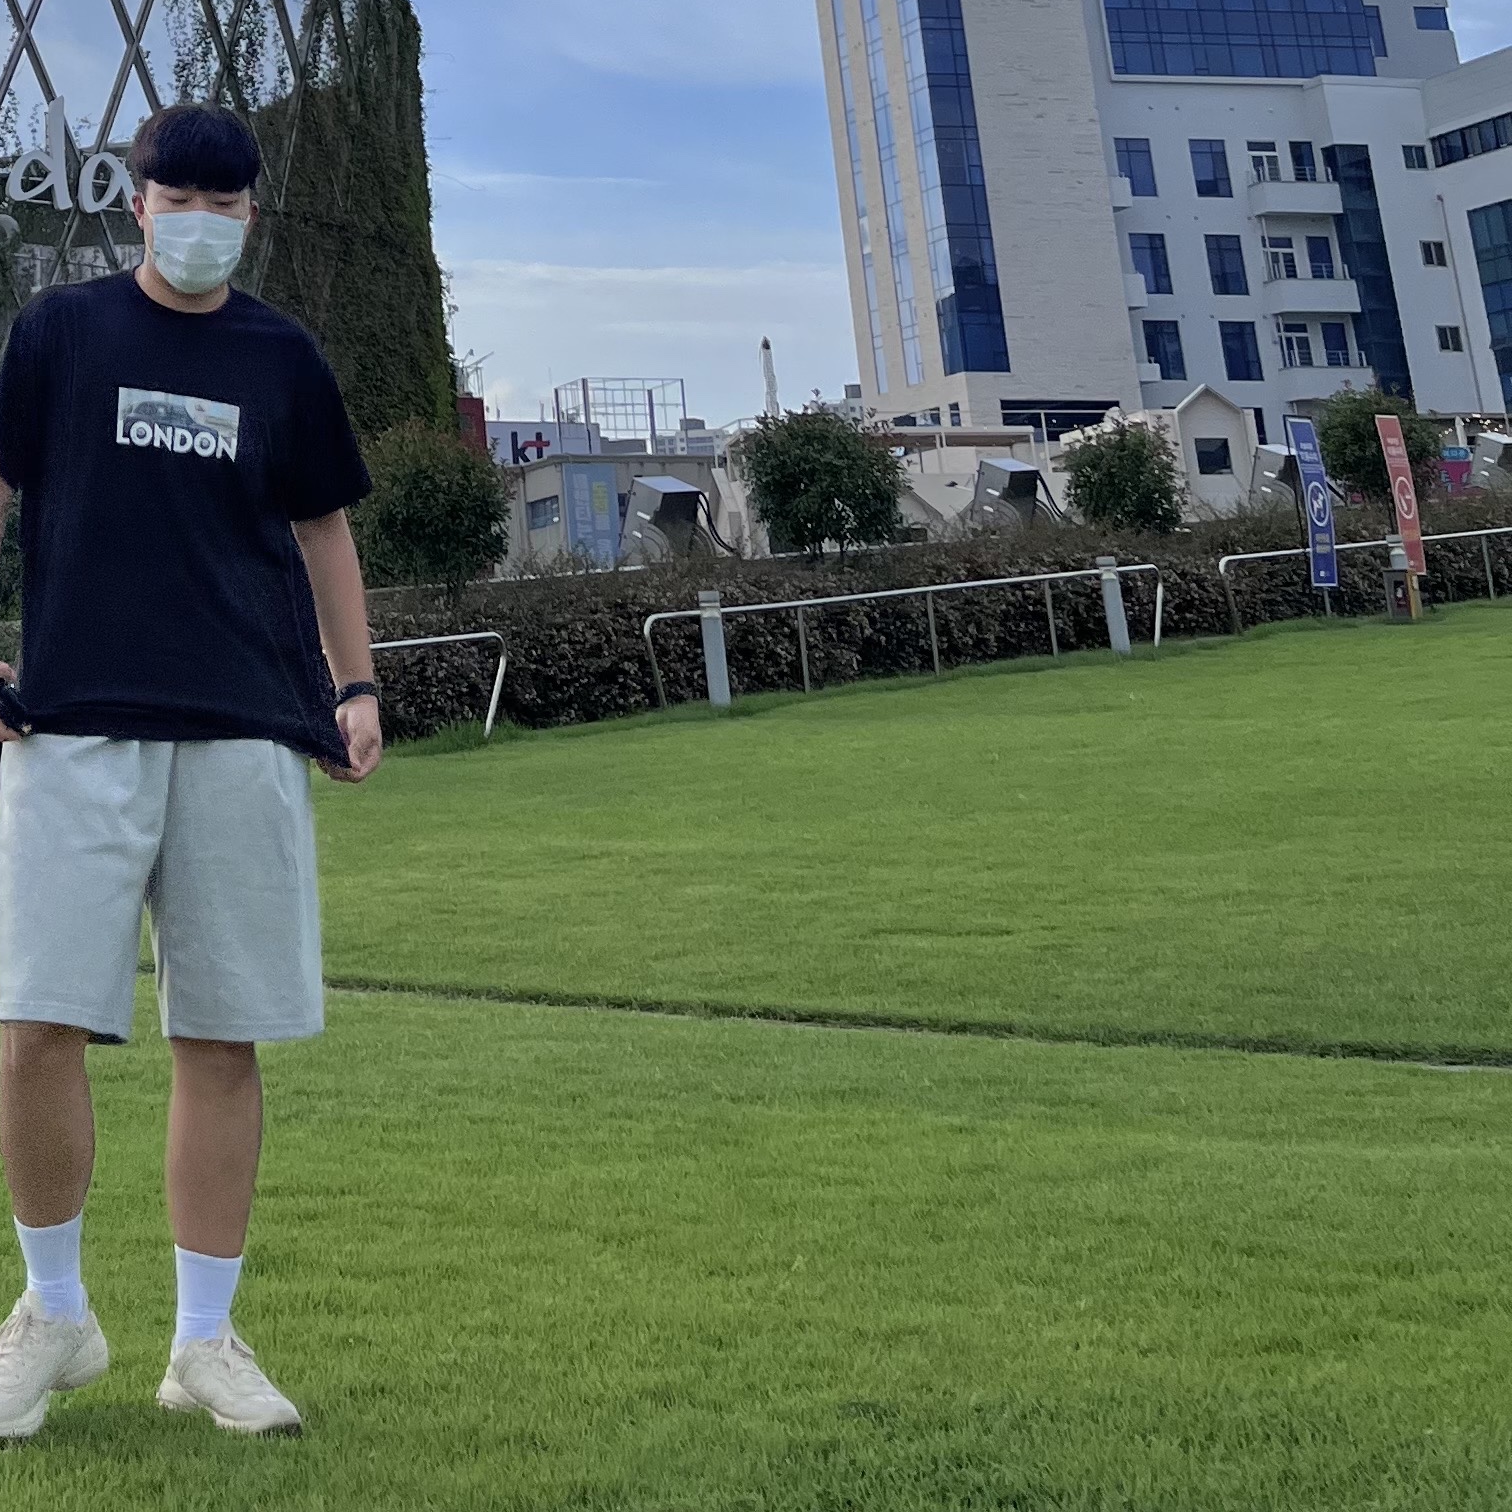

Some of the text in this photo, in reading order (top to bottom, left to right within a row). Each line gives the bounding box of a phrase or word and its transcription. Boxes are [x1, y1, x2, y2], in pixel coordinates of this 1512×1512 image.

[5, 94, 136, 214] da
[116, 419, 238, 463] LONDON
[510, 431, 551, 465] kt
